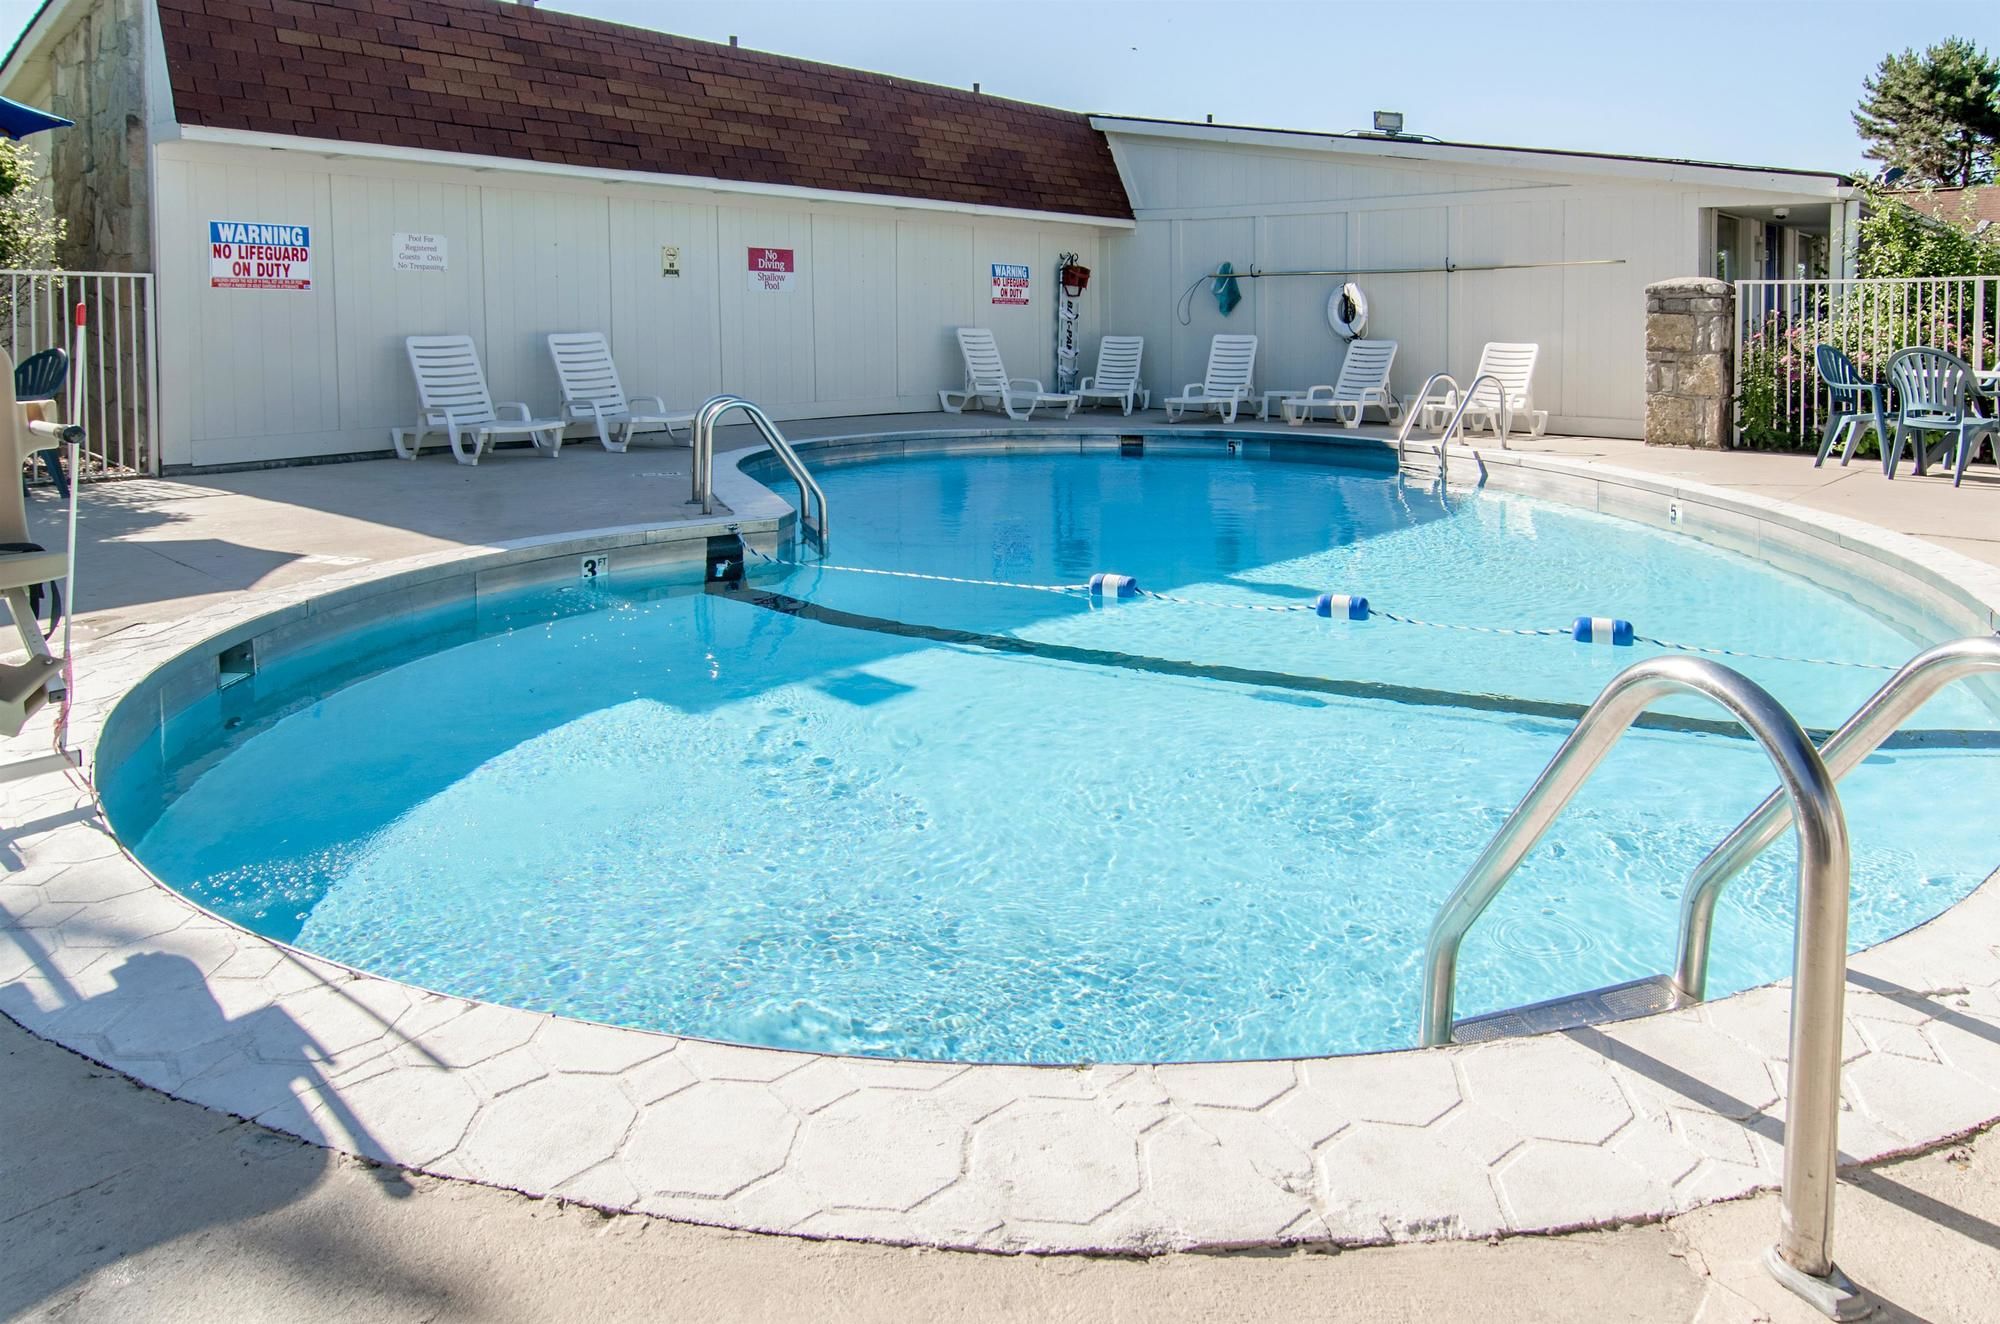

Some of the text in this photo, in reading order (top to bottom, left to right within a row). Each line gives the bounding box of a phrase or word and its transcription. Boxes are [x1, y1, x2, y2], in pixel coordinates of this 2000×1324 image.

[218, 223, 303, 246] WARNING
[213, 244, 308, 262] NO LIFEGUARD
[405, 244, 437, 252] Registered
[766, 250, 778, 260] No
[233, 261, 290, 278] ON DUTY
[410, 262, 444, 272] Trespassing
[758, 258, 785, 271] Diving
[995, 264, 1027, 278] WARNING
[758, 272, 785, 282] Shallow
[993, 277, 1029, 288] NO LIFEGUARD
[764, 281, 780, 290] Pool
[1001, 288, 1022, 297] ON DUTY
[584, 558, 607, 577] 3 FT
